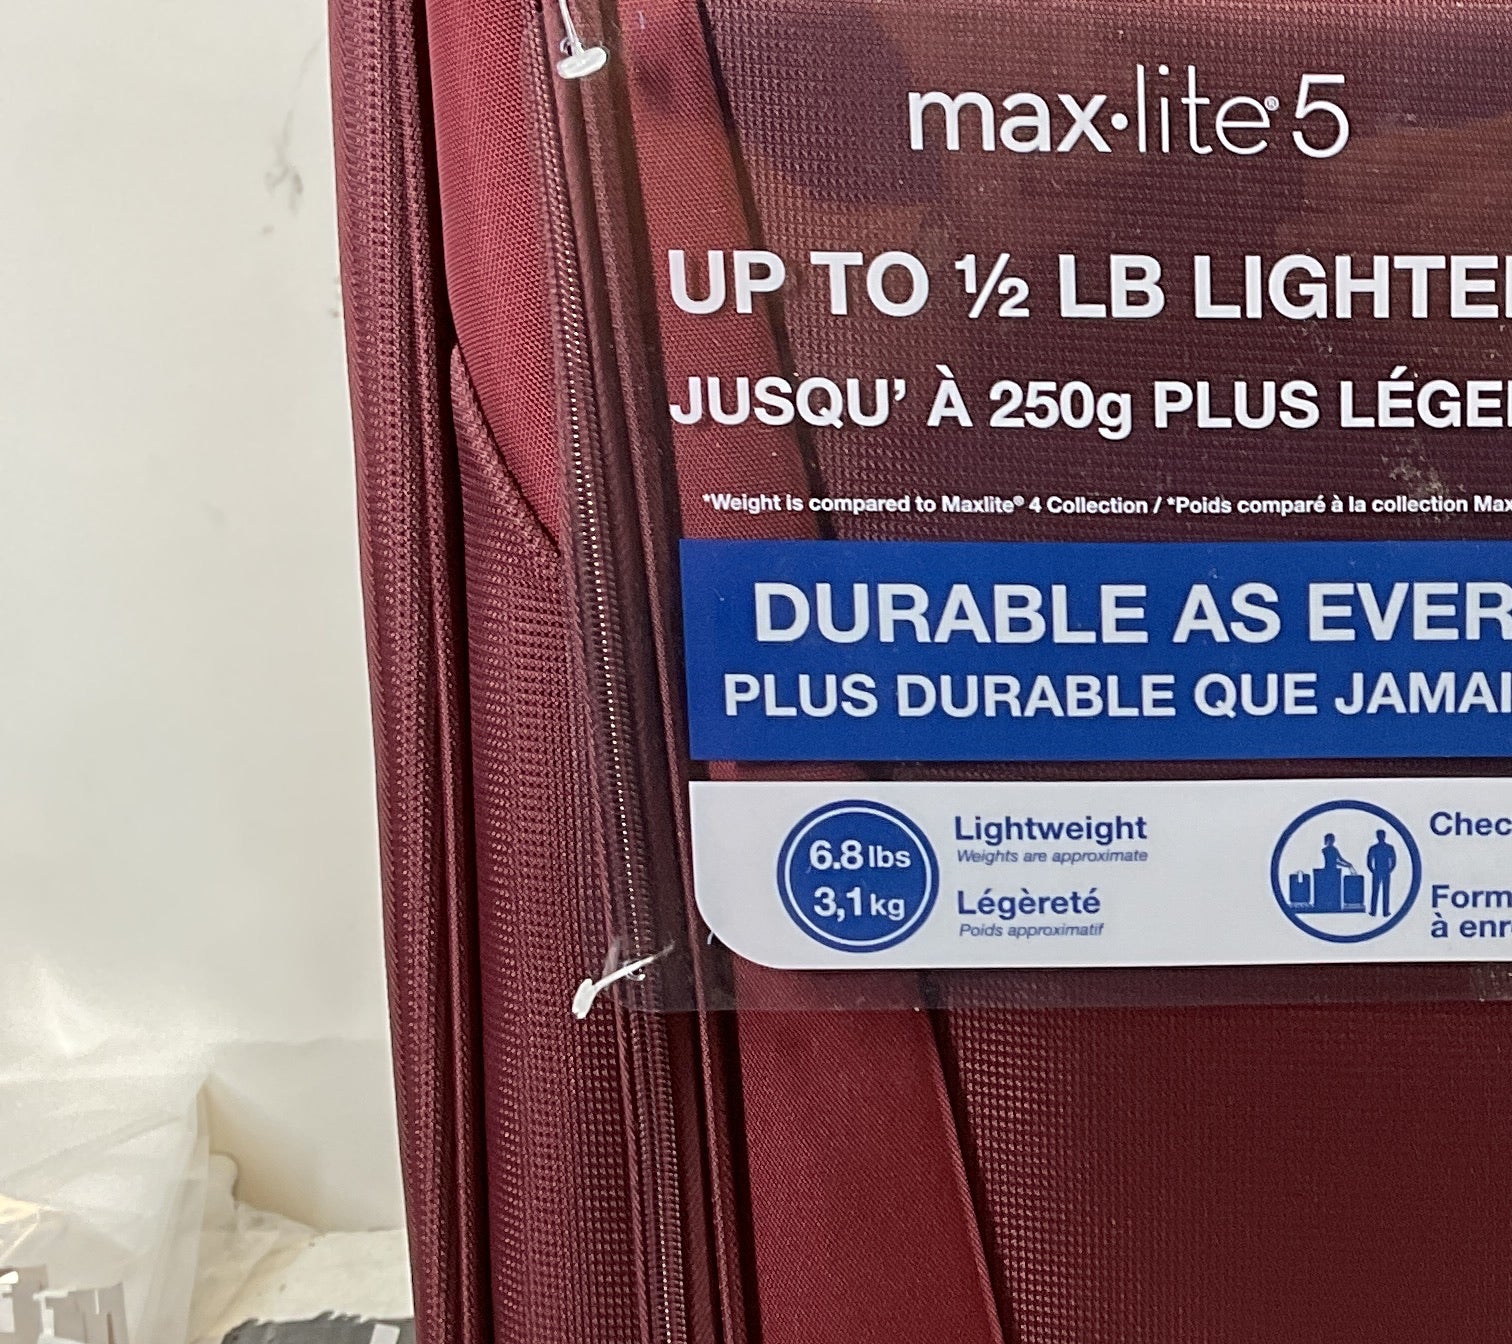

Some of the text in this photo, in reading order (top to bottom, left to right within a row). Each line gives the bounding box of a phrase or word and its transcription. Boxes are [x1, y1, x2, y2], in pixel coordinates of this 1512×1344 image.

[667, 249, 785, 316] UP
[812, 250, 930, 318] TO
[1059, 254, 1166, 319] LB
[927, 365, 972, 428] À
[989, 381, 1133, 441] 250g
[1155, 379, 1319, 428] PLUS
[786, 496, 803, 511] is
[809, 496, 910, 515] compared
[915, 498, 936, 512] to
[1029, 498, 1042, 513] 4
[1046, 497, 1148, 514] Collection
[1153, 497, 1160, 513] /
[1237, 495, 1326, 517] comparé
[1331, 495, 1343, 513] à
[1348, 497, 1366, 513] la
[1371, 496, 1468, 513] collection
[754, 583, 1148, 644] DURABLE
[1173, 583, 1281, 644] AS
[724, 674, 877, 717] PLUS
[898, 675, 1176, 718] DURABLE
[1193, 673, 1319, 718] QUE
[954, 816, 1147, 846] Lightweight
[809, 839, 911, 870] 6.8 lbs
[958, 849, 1148, 865] Weights are approximate
[814, 886, 905, 922] 3,1 kg
[958, 888, 1101, 920] Légèreté
[959, 923, 1104, 938] Poids approximatif
[1431, 913, 1448, 938] à
